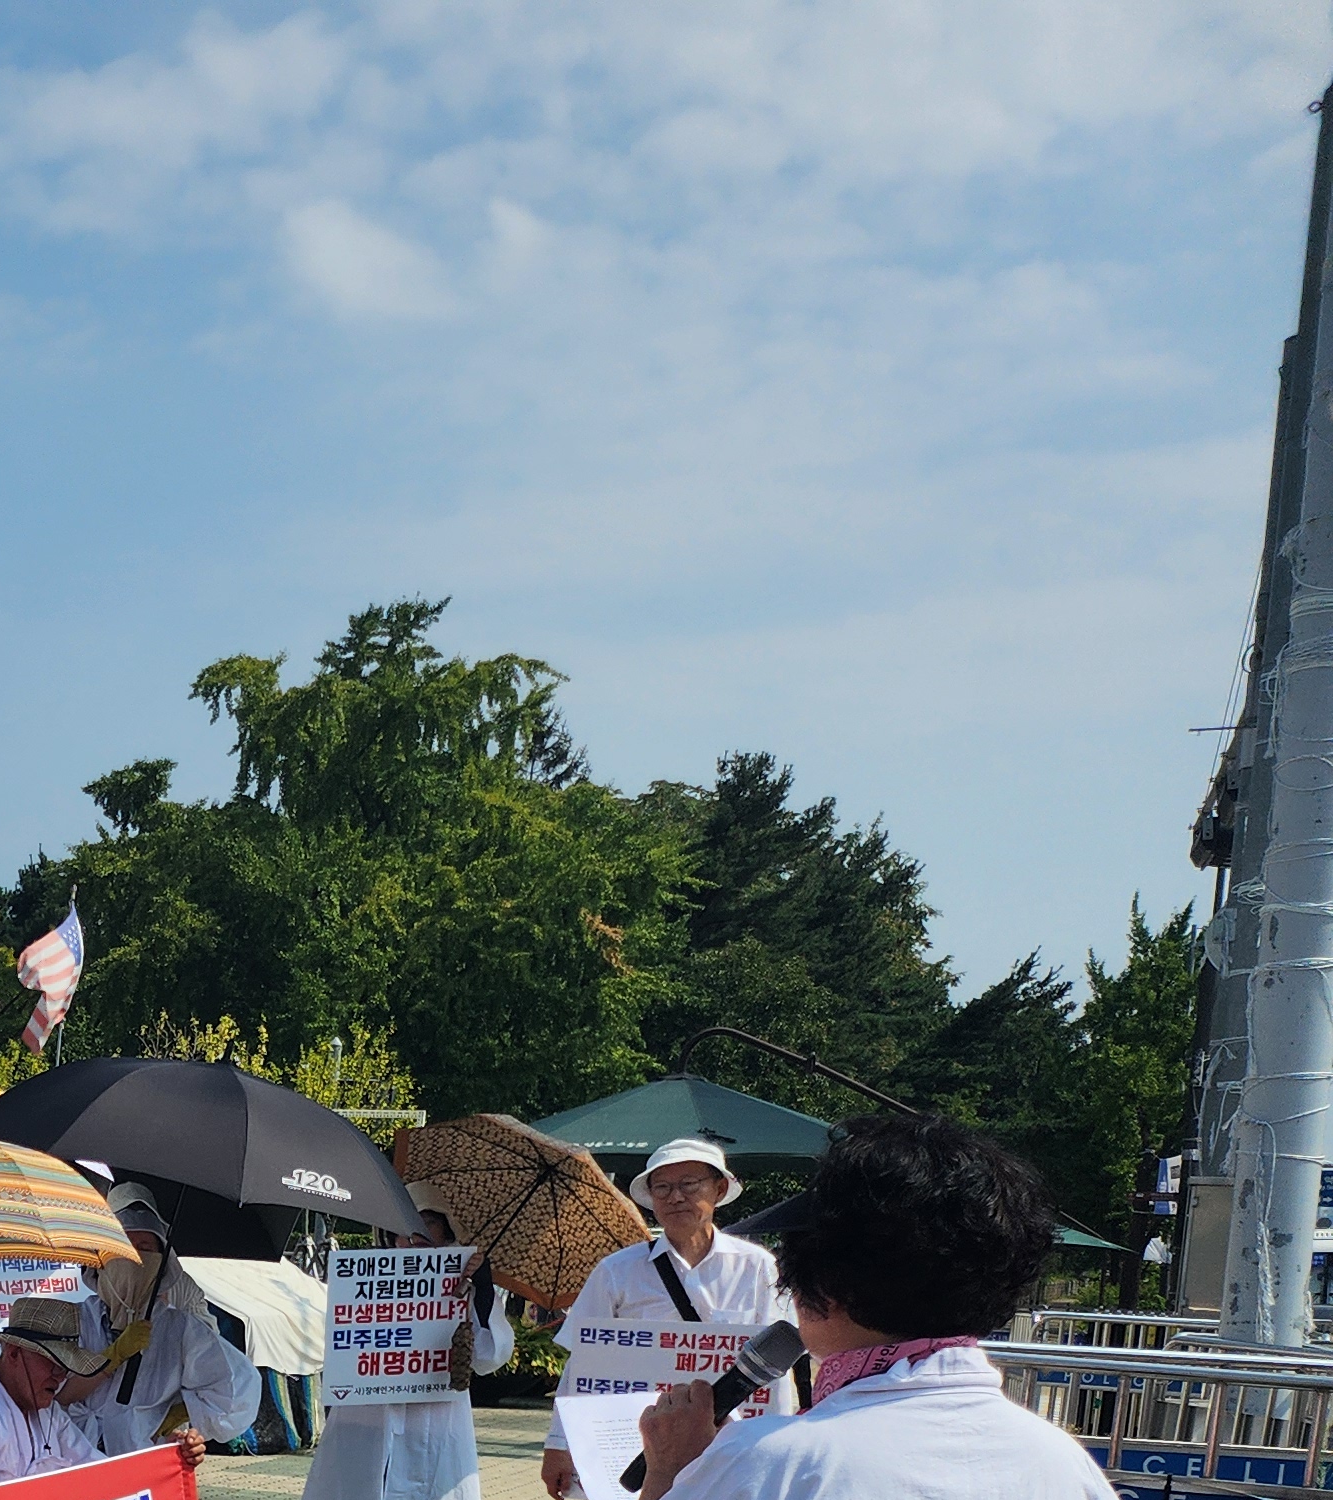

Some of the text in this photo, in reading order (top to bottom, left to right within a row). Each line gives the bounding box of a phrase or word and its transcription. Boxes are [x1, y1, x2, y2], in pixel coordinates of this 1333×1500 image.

[293, 1169, 338, 1192] 120
[335, 1253, 463, 1278] 장애인 탈시설
[354, 1277, 435, 1300] 지원법이
[333, 1299, 469, 1325] 민생법안이냐?
[332, 1327, 413, 1351] 민주당은
[579, 1327, 654, 1348] 민주당은
